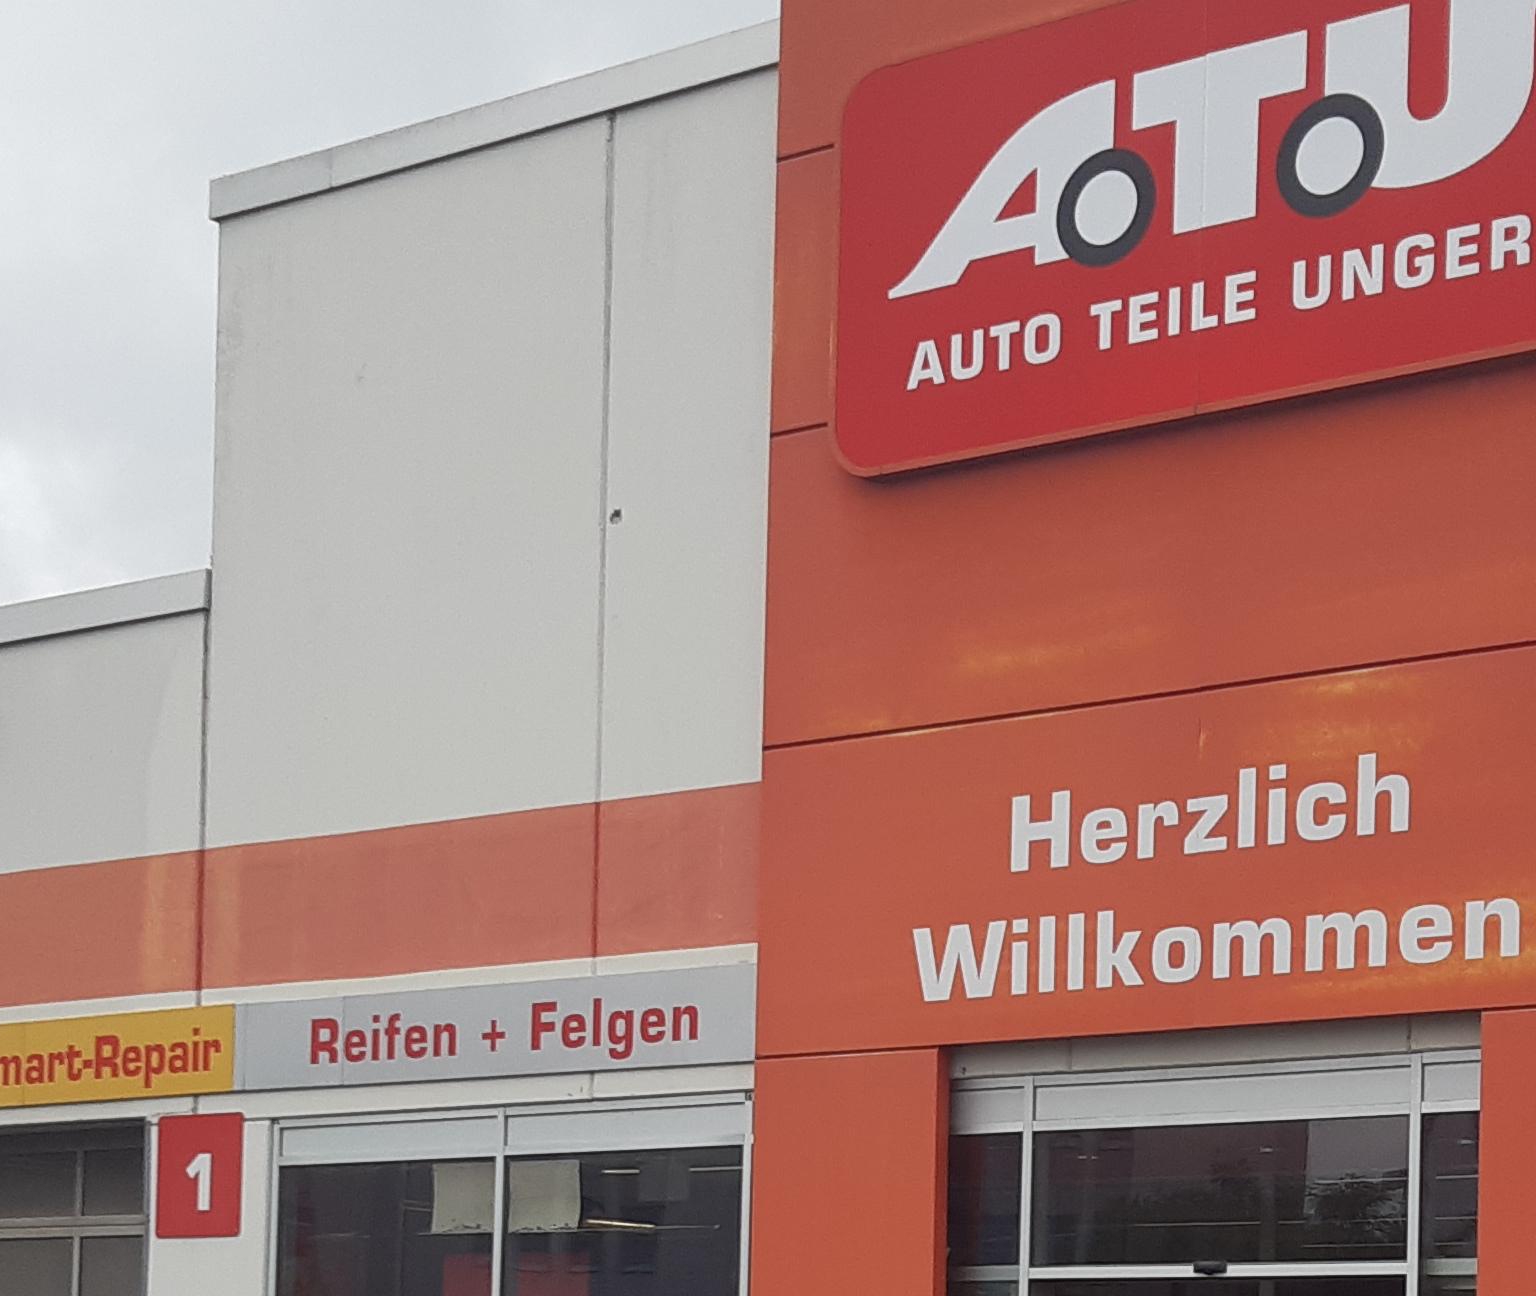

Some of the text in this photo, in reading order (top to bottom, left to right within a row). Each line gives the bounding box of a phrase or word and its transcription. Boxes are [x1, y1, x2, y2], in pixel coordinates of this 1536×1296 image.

[907, 214, 1533, 391] AUTO TEILE UNGER
[1010, 753, 1410, 873] Herzlich
[912, 896, 1520, 1002] Willkommen
[309, 998, 700, 1065] Reifen + Felgen
[185, 1152, 213, 1211] 1
